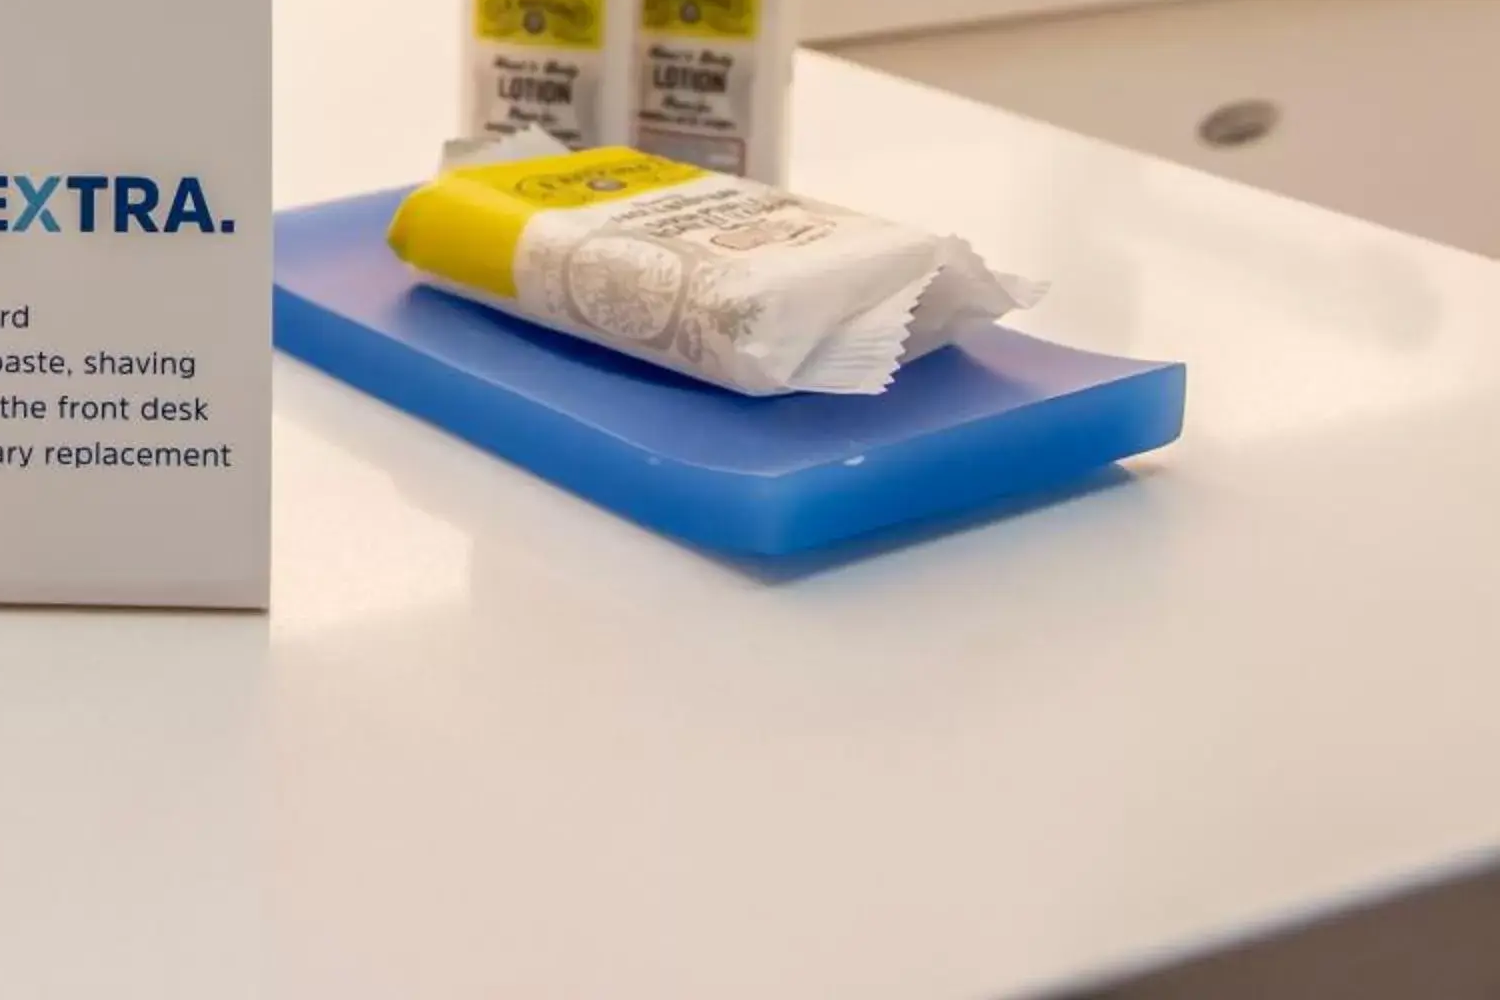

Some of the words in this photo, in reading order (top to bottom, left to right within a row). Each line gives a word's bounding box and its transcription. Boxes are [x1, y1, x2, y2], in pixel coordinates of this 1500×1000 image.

[497, 76, 573, 105] LOTION
[652, 66, 728, 93] LOTION
[84, 351, 195, 379] shaving
[0, 395, 46, 419] the
[58, 395, 130, 420] front
[141, 397, 208, 421] desk
[45, 442, 231, 468] replacement
